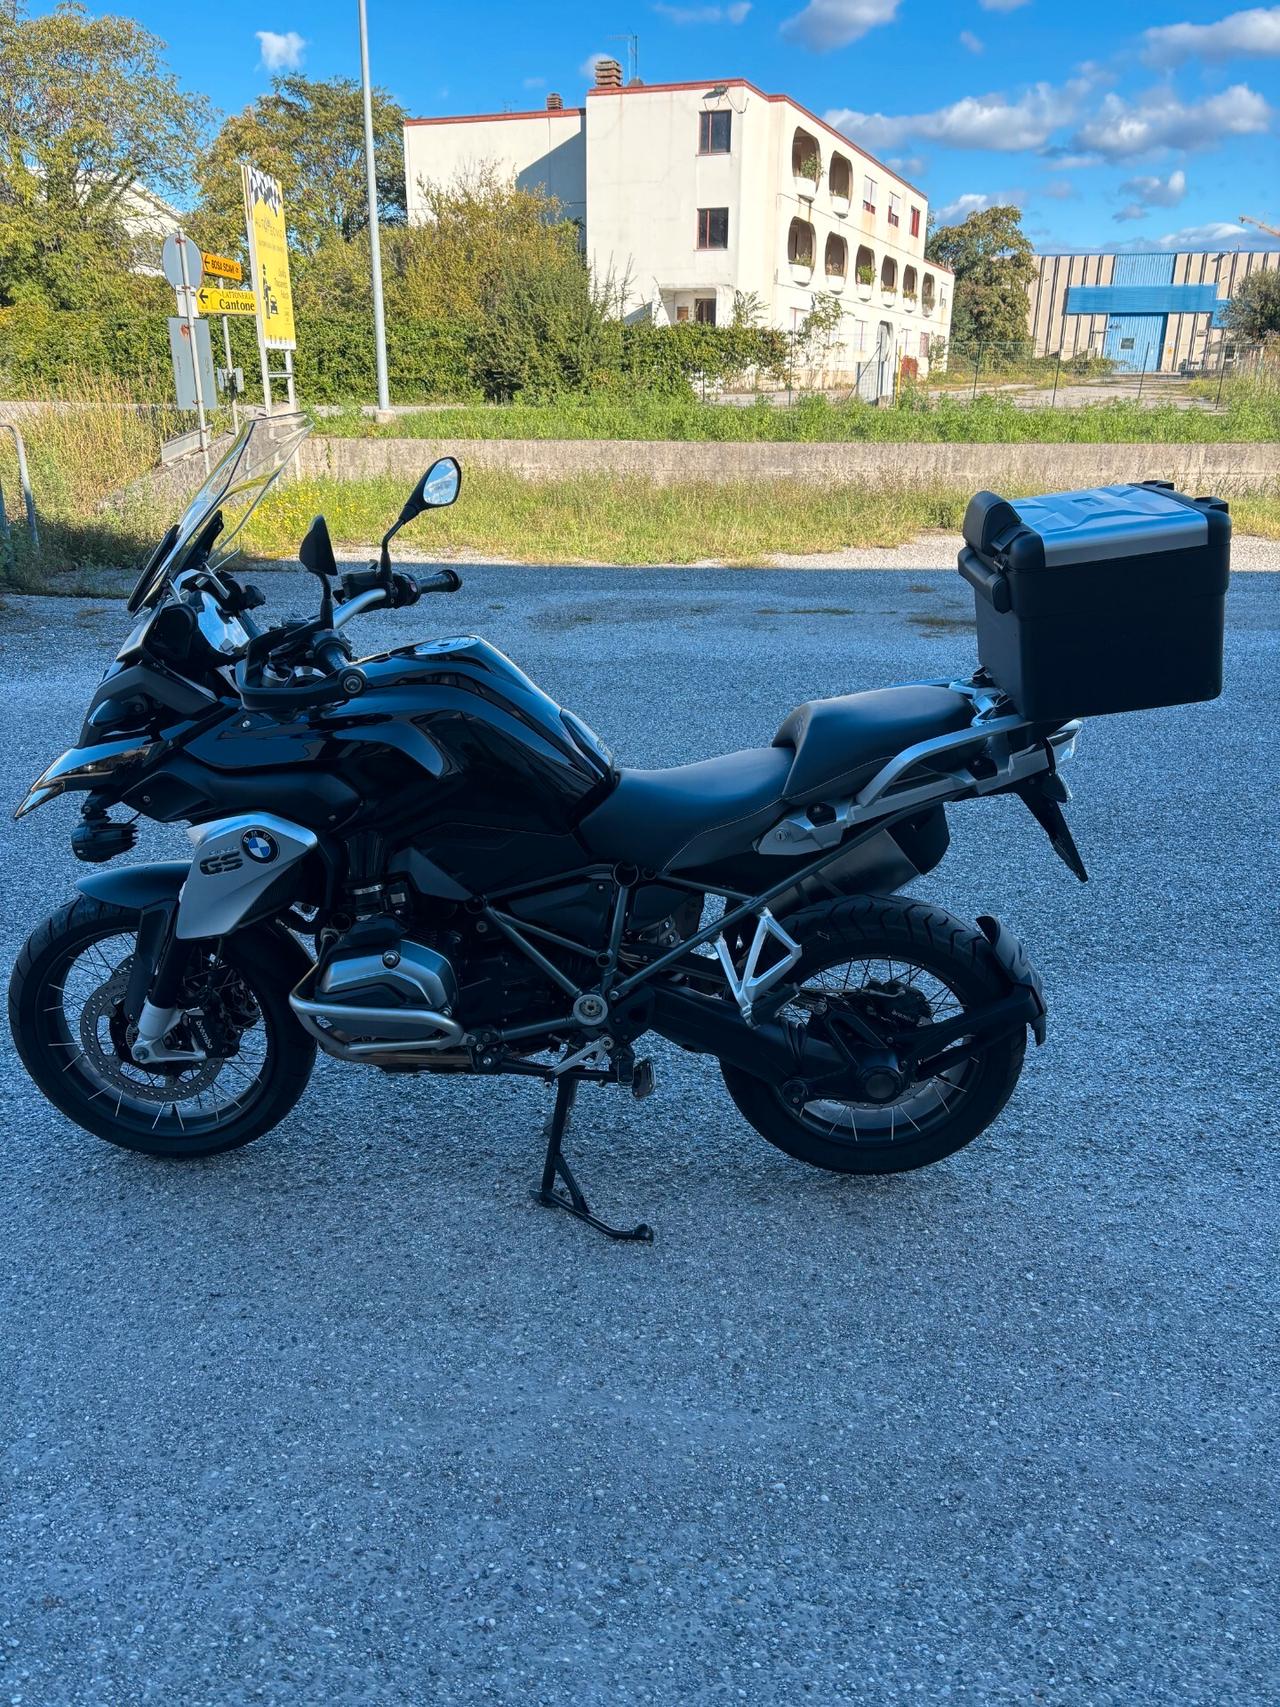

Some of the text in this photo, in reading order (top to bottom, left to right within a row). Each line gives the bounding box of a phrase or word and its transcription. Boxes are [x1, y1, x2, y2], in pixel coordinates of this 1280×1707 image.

[219, 298, 255, 311] Cantone
[243, 830, 272, 844] BMW
[200, 851, 243, 875] GS
